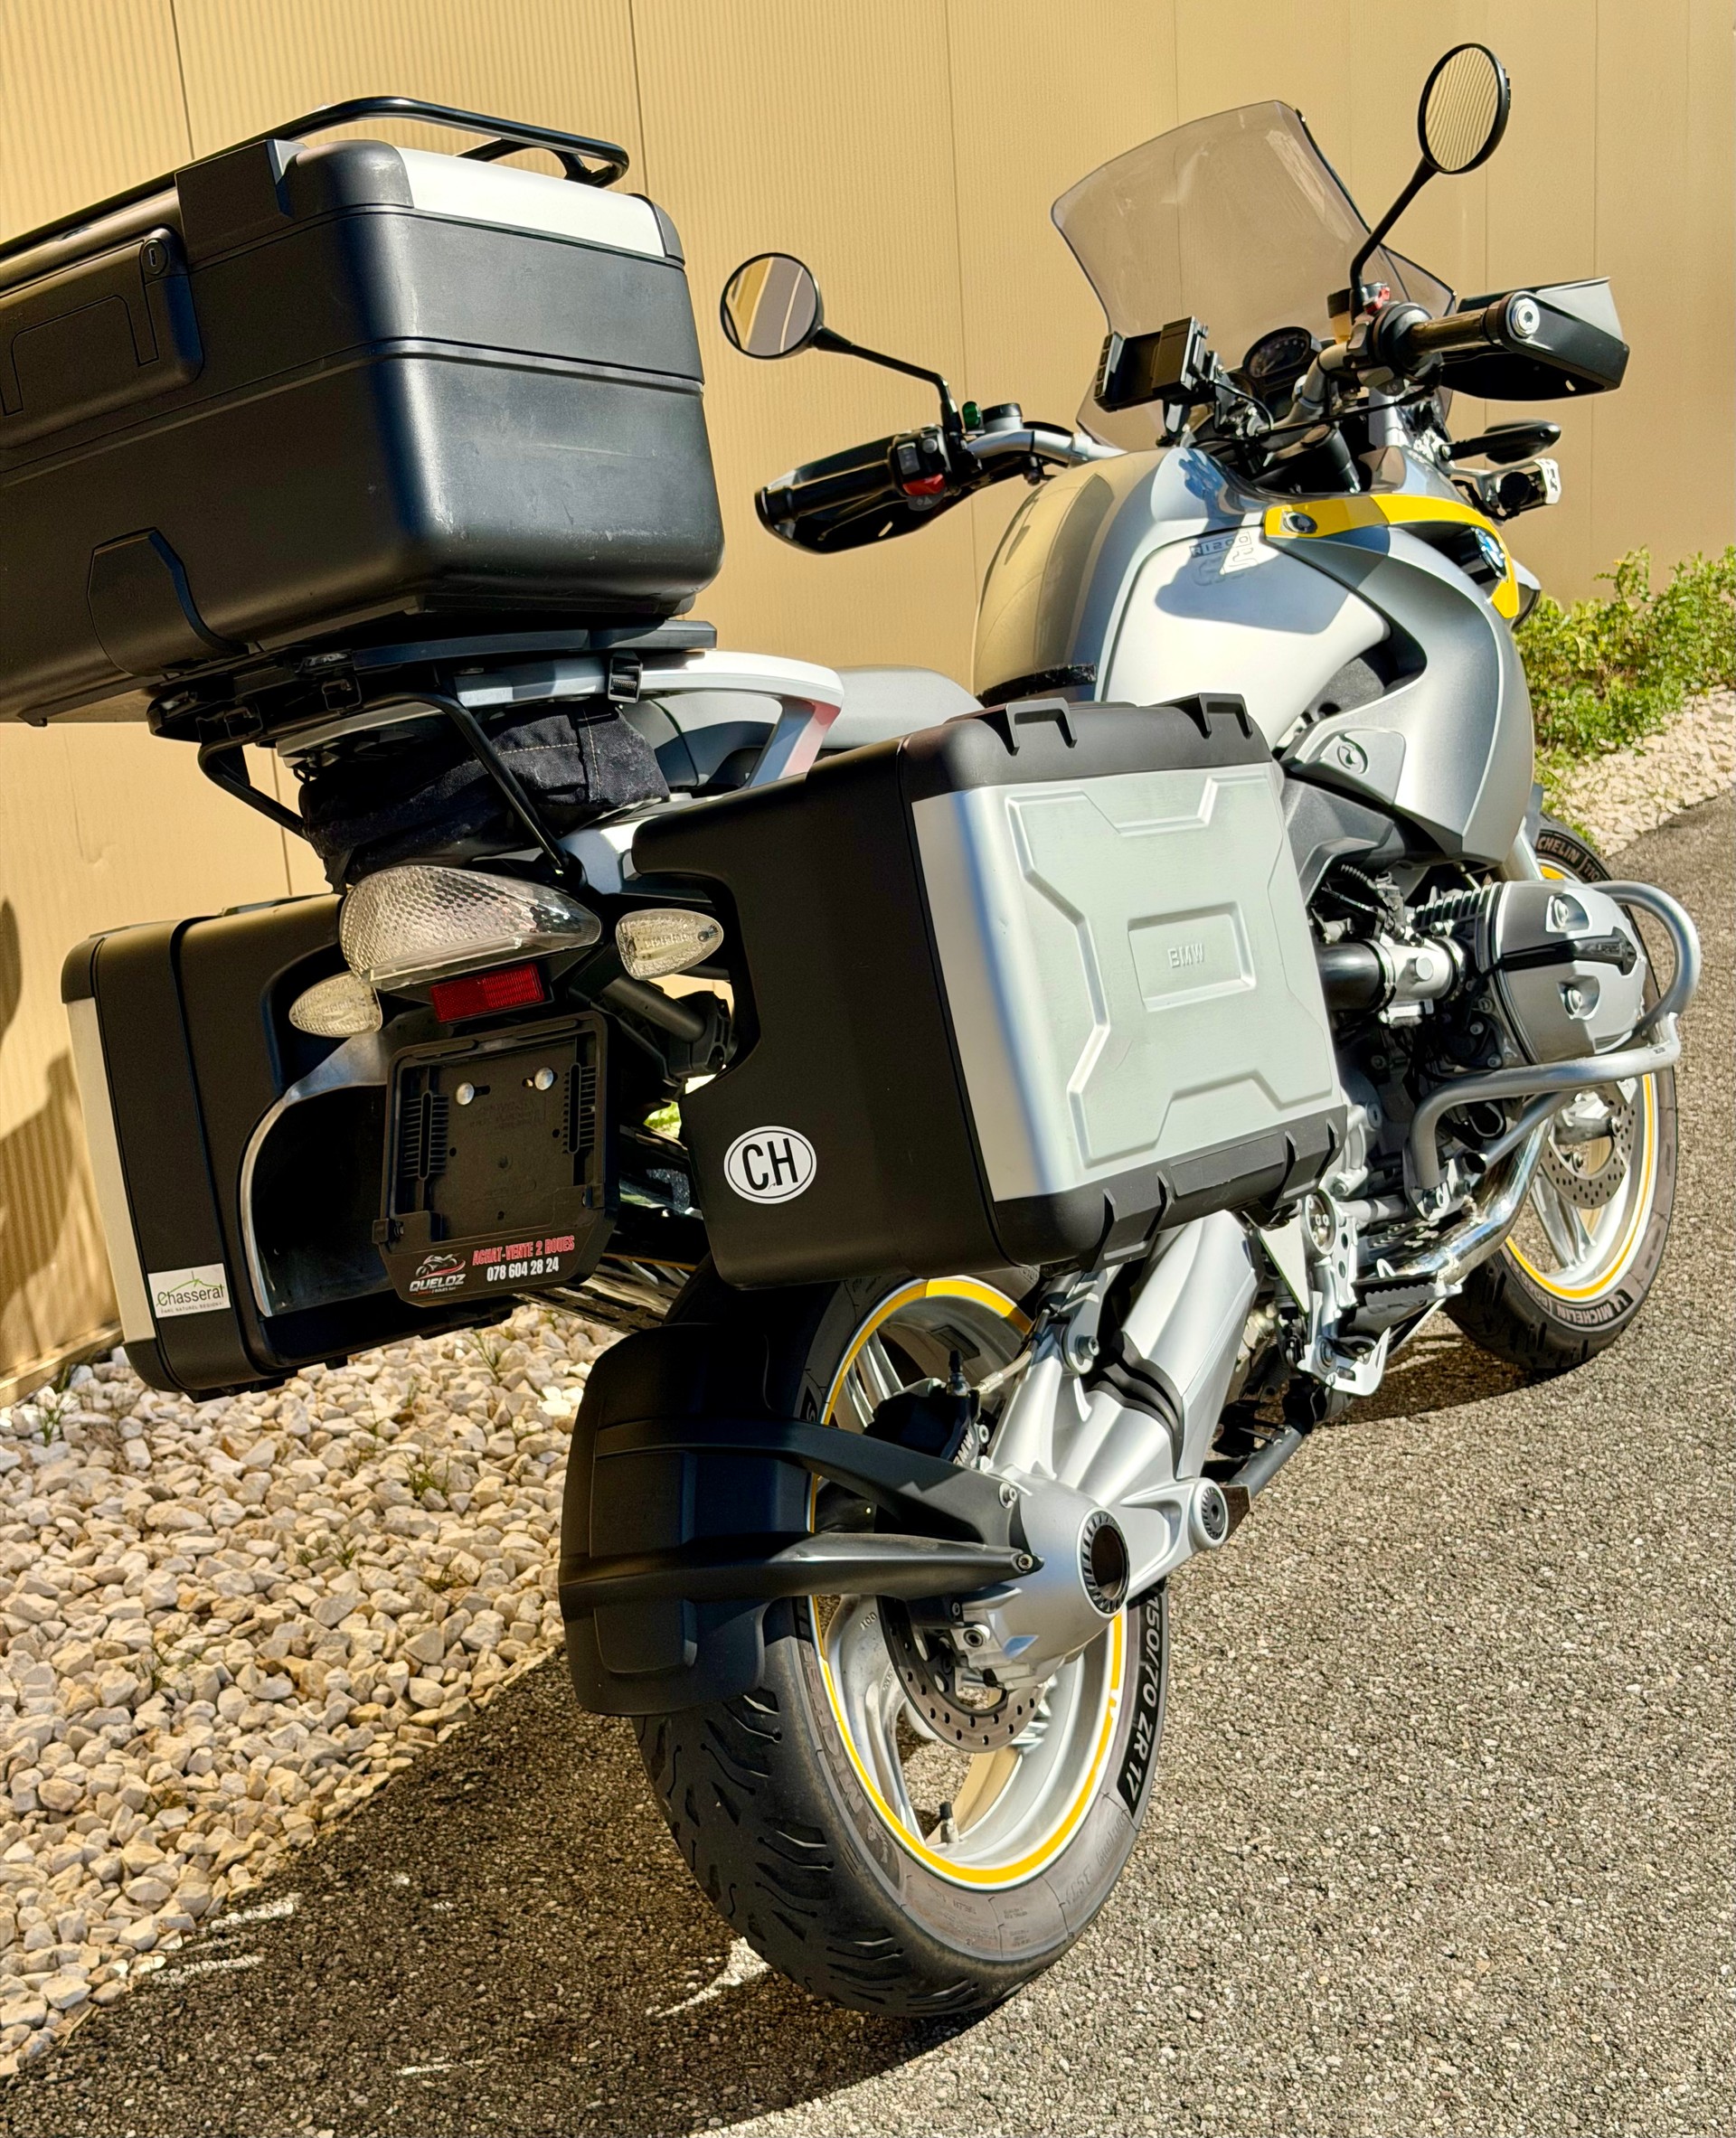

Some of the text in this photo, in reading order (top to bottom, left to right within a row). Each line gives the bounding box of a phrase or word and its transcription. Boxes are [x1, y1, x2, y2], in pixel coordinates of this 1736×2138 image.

[1537, 835, 1580, 864] CHELIN
[1167, 943, 1204, 968] BMW
[741, 1137, 798, 1191] CH
[472, 1235, 575, 1266] ACHAT-VENTE 2 ROUES
[409, 1273, 467, 1293] QUELOZ
[486, 1257, 560, 1282] 078 604 28 24
[156, 1283, 224, 1306] Chasseral
[1556, 1301, 1614, 1324] MICHELIN
[1134, 1711, 1153, 1761] ZR
[1126, 1762, 1143, 1802] 17
